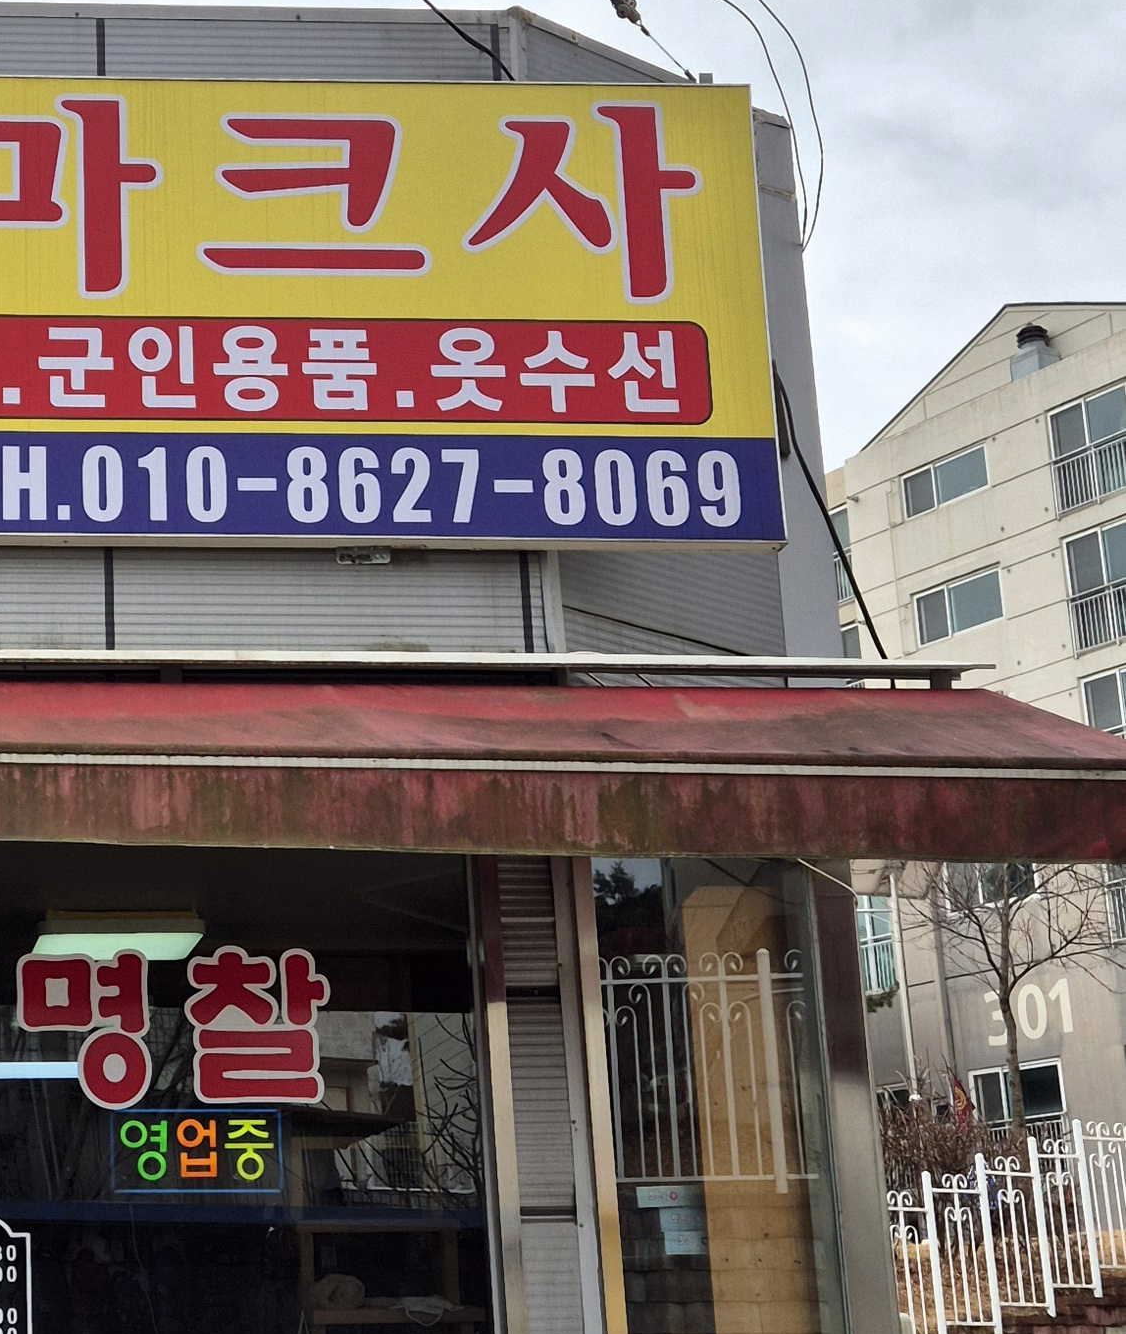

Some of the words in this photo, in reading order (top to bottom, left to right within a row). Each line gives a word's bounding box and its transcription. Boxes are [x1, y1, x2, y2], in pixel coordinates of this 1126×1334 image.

[2, 443, 742, 528] H.010-8627-8069
[16, 945, 330, 1110] 명찰
[984, 977, 1073, 1046] 301
[120, 1118, 274, 1182] 영업중
